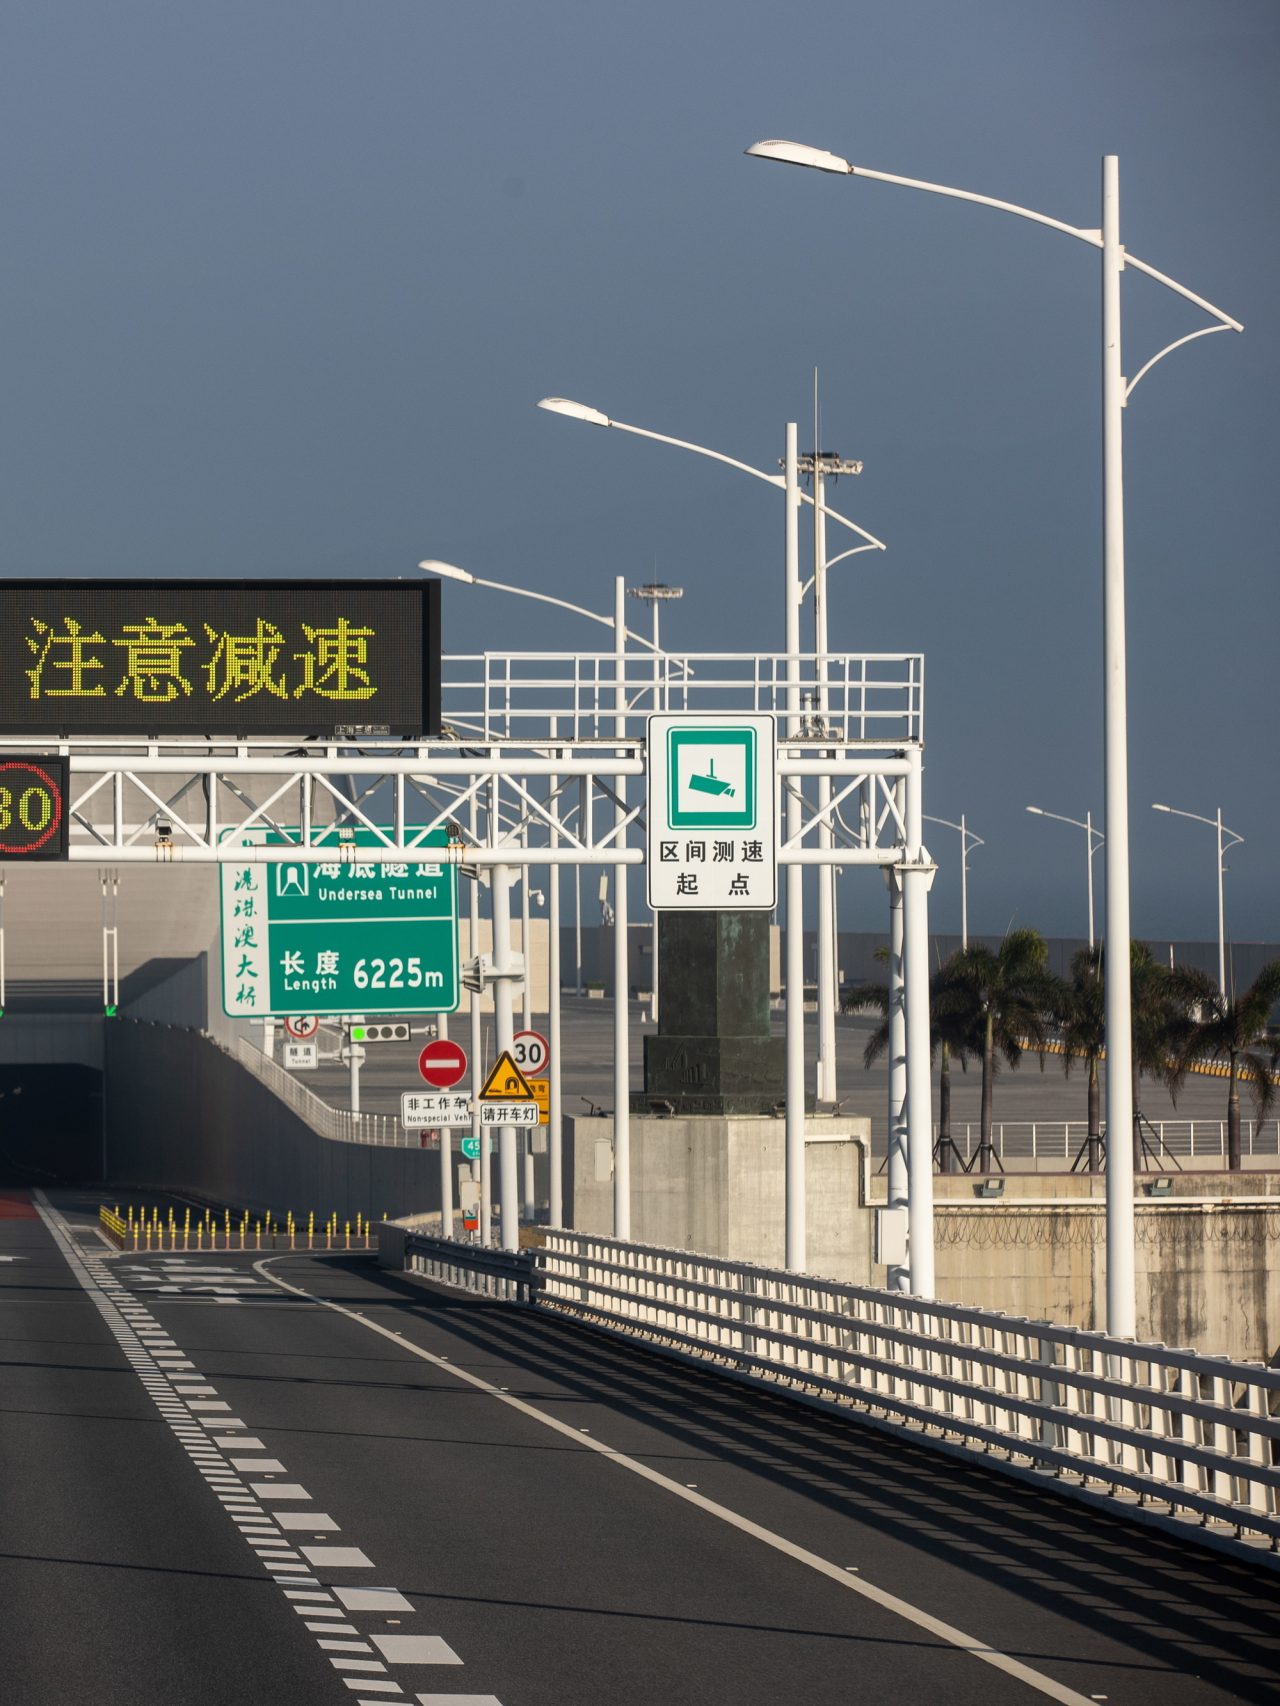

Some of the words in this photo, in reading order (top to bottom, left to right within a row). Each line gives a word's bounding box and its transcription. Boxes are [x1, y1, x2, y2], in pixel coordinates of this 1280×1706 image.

[25, 616, 378, 702] 注意减速
[659, 839, 764, 863] 区间测速
[318, 887, 383, 901] Undersea
[389, 886, 437, 900] Tunnel
[676, 872, 750, 896] 起点
[233, 866, 259, 1008] 港珠澳大桥
[279, 949, 340, 976] 长度
[353, 957, 444, 989] 6225m
[284, 977, 337, 994] Length
[514, 1043, 542, 1064] 30
[483, 1107, 536, 1122] 请开车灯
